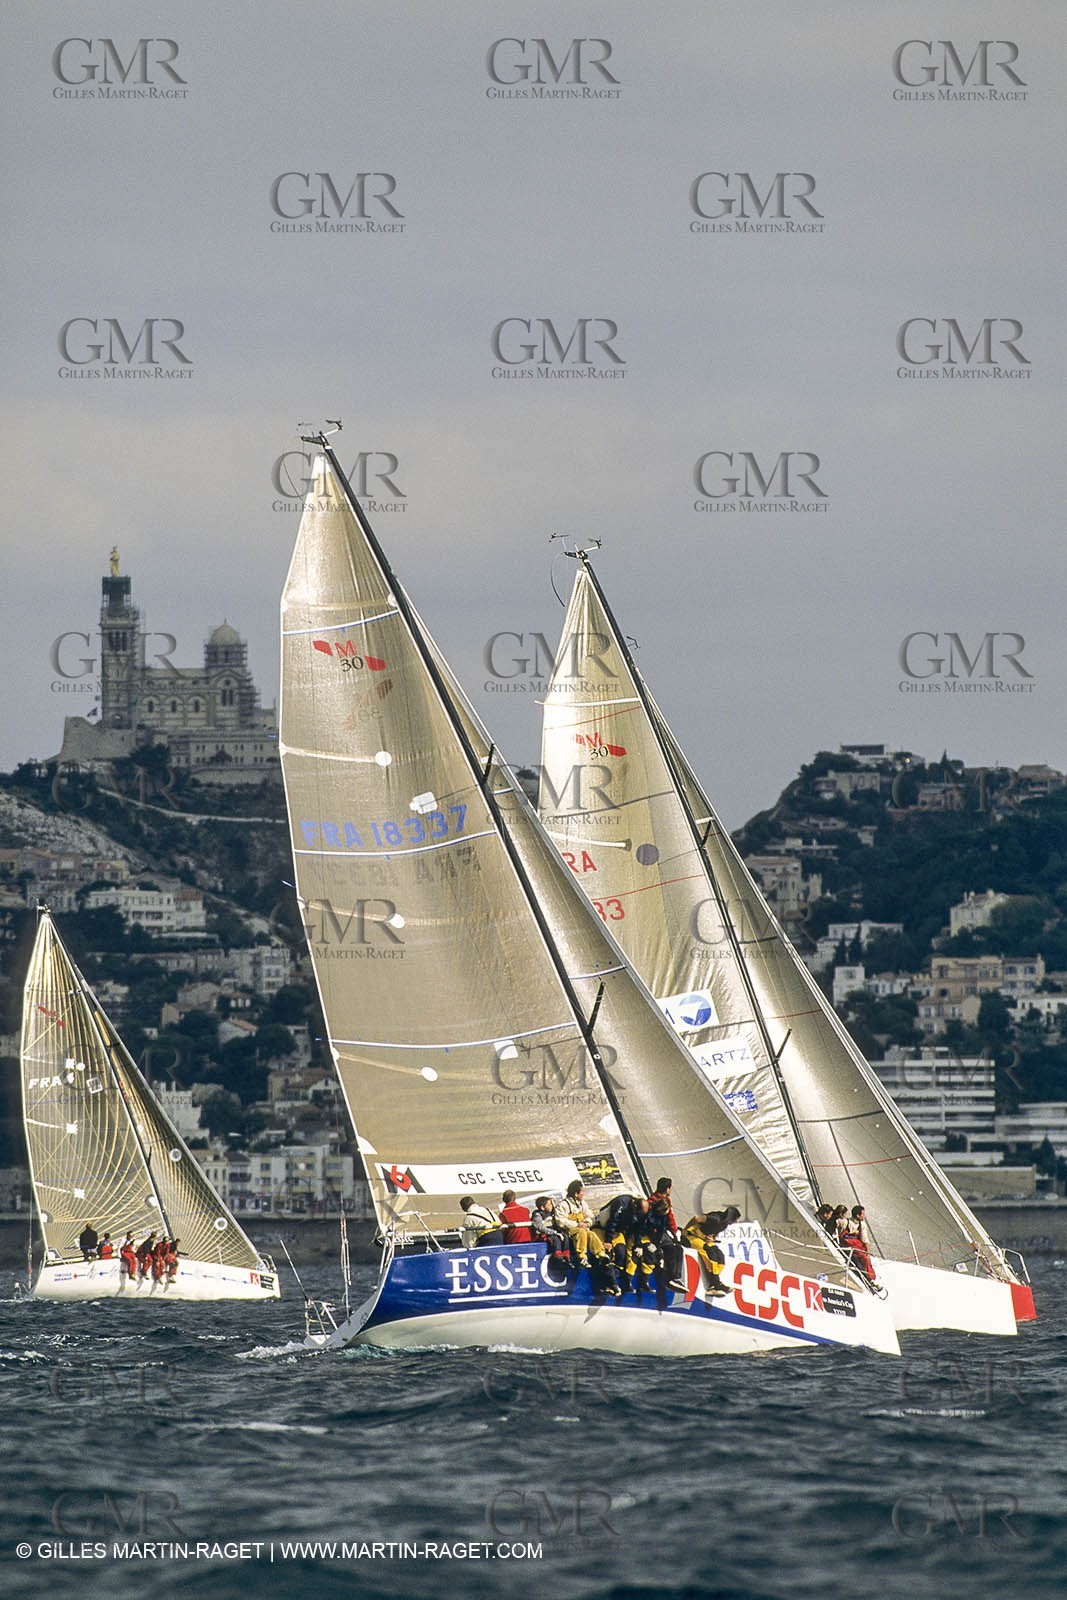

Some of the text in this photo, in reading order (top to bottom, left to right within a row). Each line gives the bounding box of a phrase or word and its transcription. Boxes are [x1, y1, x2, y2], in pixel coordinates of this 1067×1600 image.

[335, 639, 357, 658] M
[341, 656, 364, 672] 30
[590, 745, 609, 760] 30
[302, 804, 467, 847] FRA 18337
[458, 1173, 486, 1185] CSC
[498, 1170, 543, 1184] ESSEC
[445, 1253, 567, 1295] ESSEC
[734, 1262, 804, 1329] CSC
